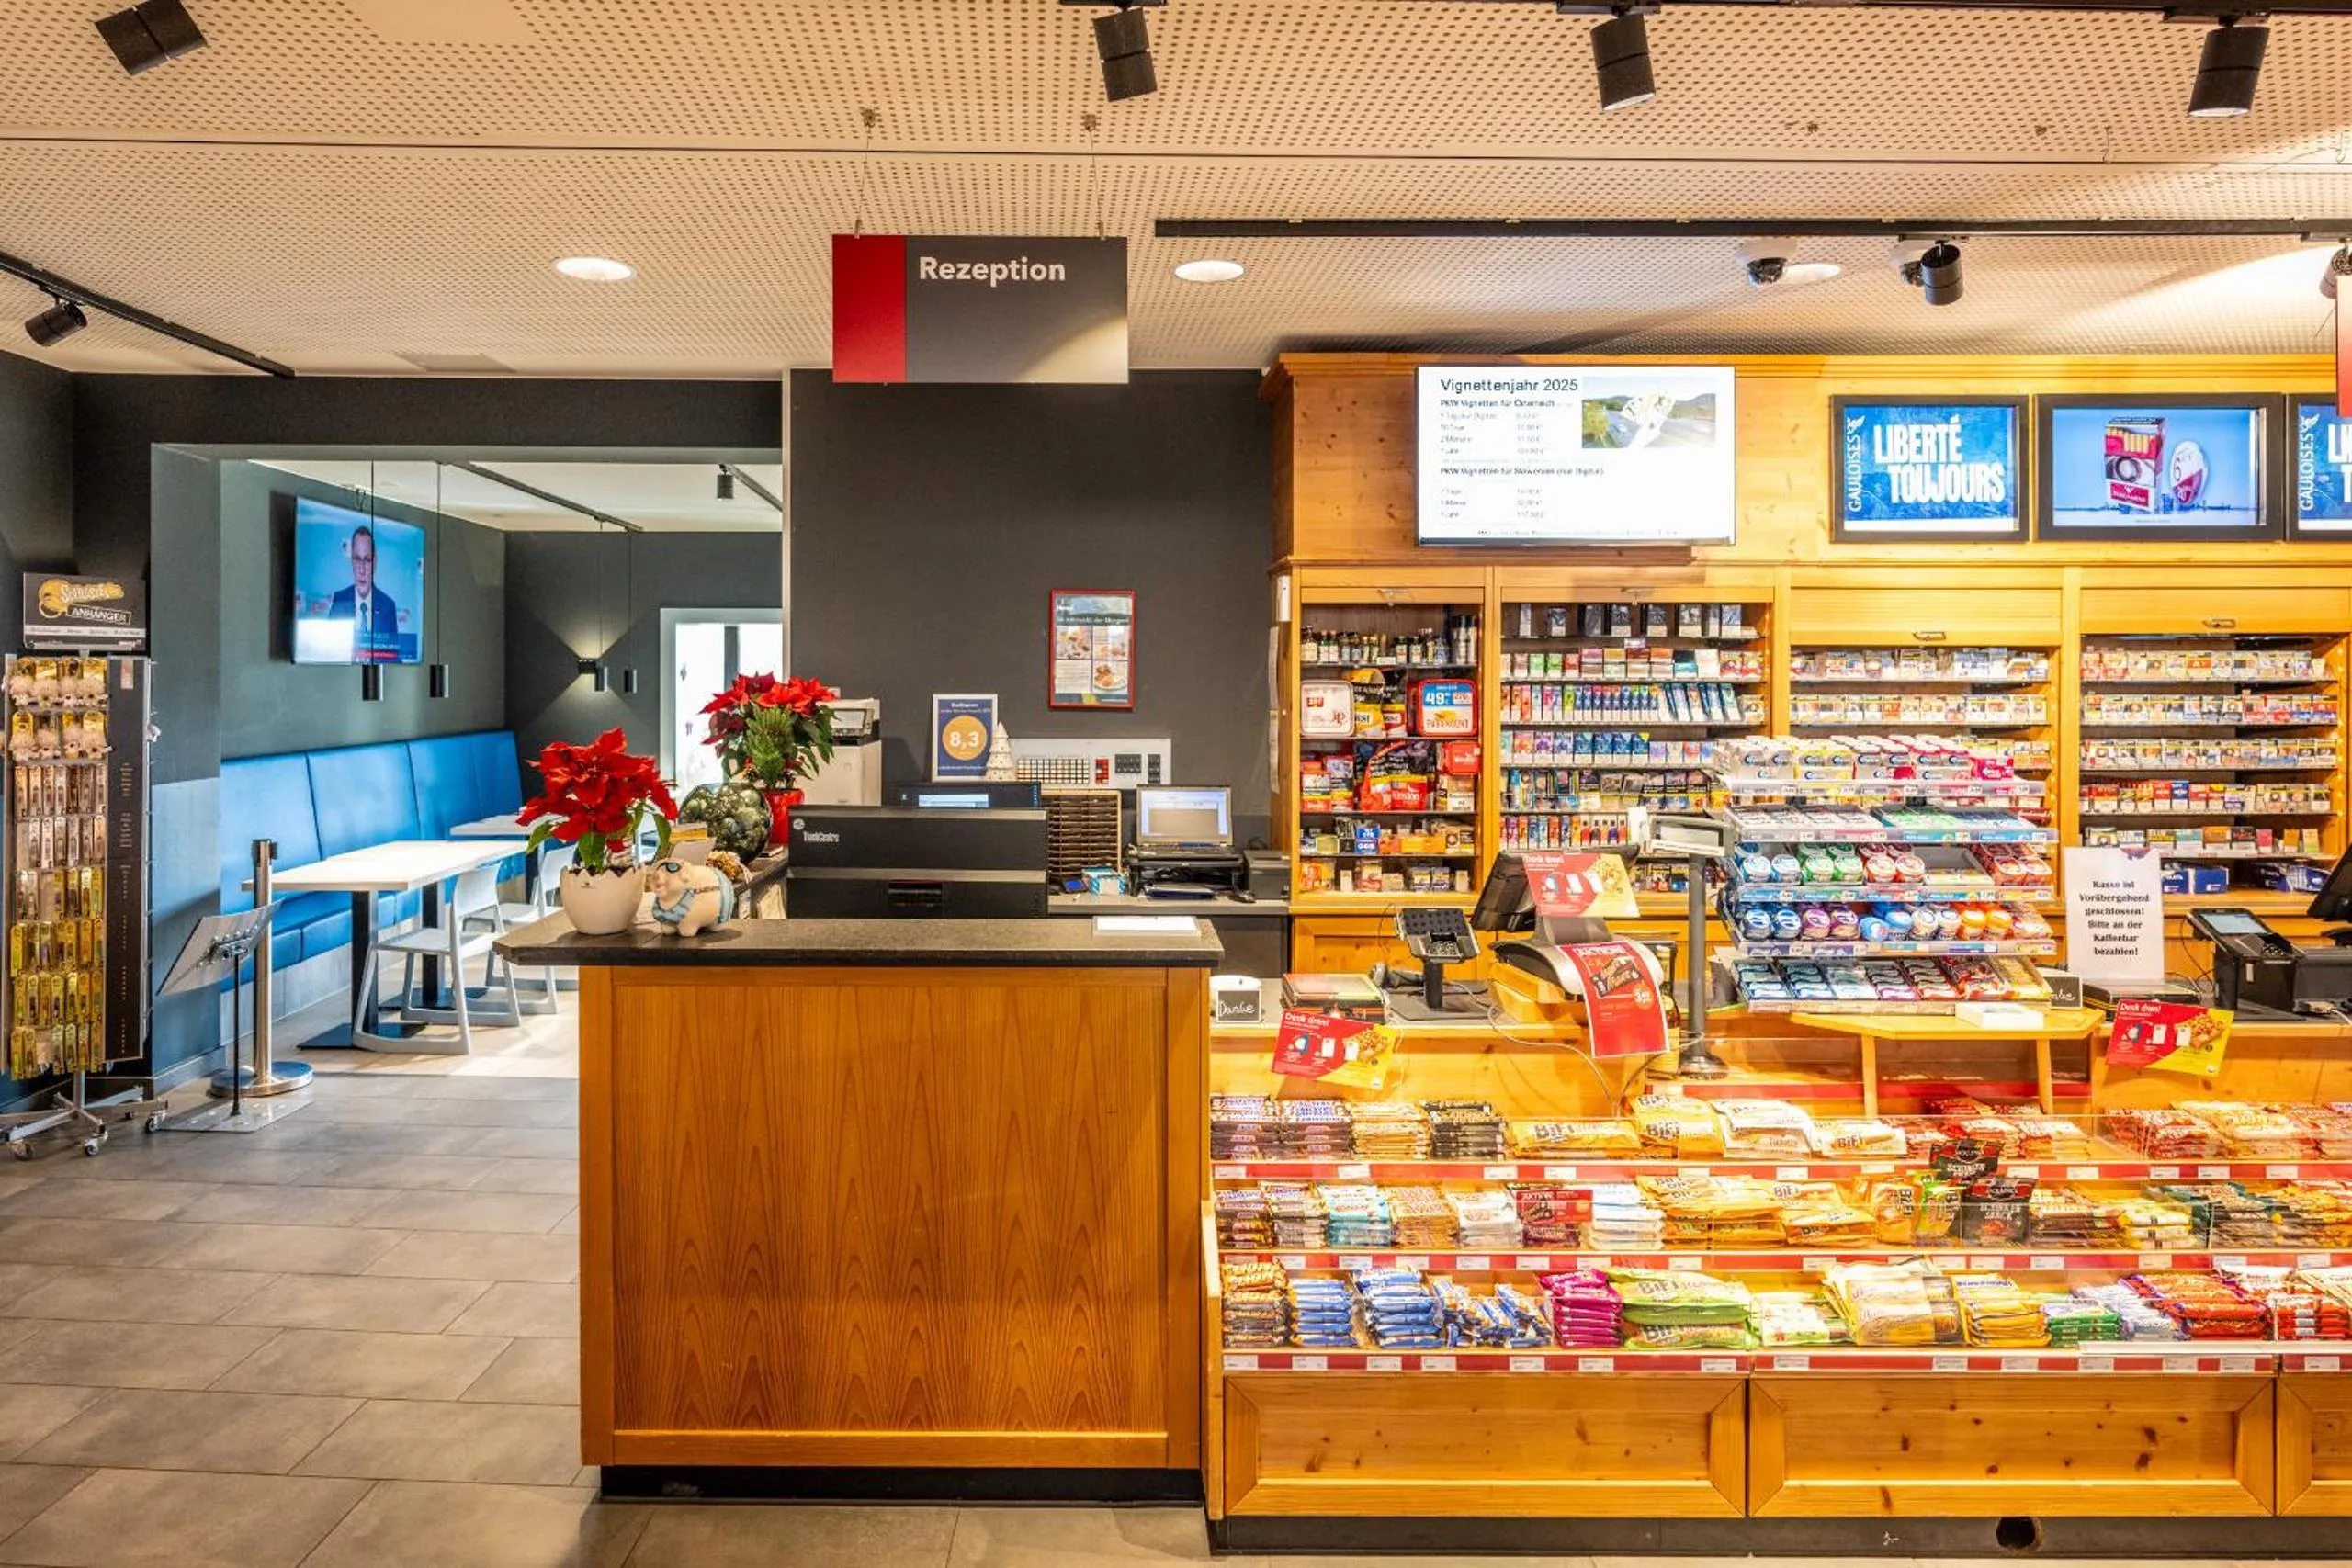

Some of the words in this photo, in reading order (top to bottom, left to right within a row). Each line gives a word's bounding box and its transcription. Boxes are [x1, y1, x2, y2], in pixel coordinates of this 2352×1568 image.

[920, 256, 1066, 288] Rezeption
[1440, 378, 1539, 394] Vignettenjahr
[1543, 378, 1578, 391] 2025
[1873, 413, 1963, 463] LIBERTÉ
[1847, 434, 1862, 513] GAULOISES
[2300, 432, 2315, 512] GAULOISES
[1887, 463, 2007, 503] TOUJOURS
[949, 730, 979, 750] 8,3
[2085, 907, 2144, 916] geschlossen!
[2088, 919, 2109, 929] Bitte
[2127, 919, 2143, 929] der
[2094, 933, 2139, 942] Kaffeebar
[2094, 946, 2139, 955] bezahlen!
[1218, 1001, 1256, 1018] Danke
